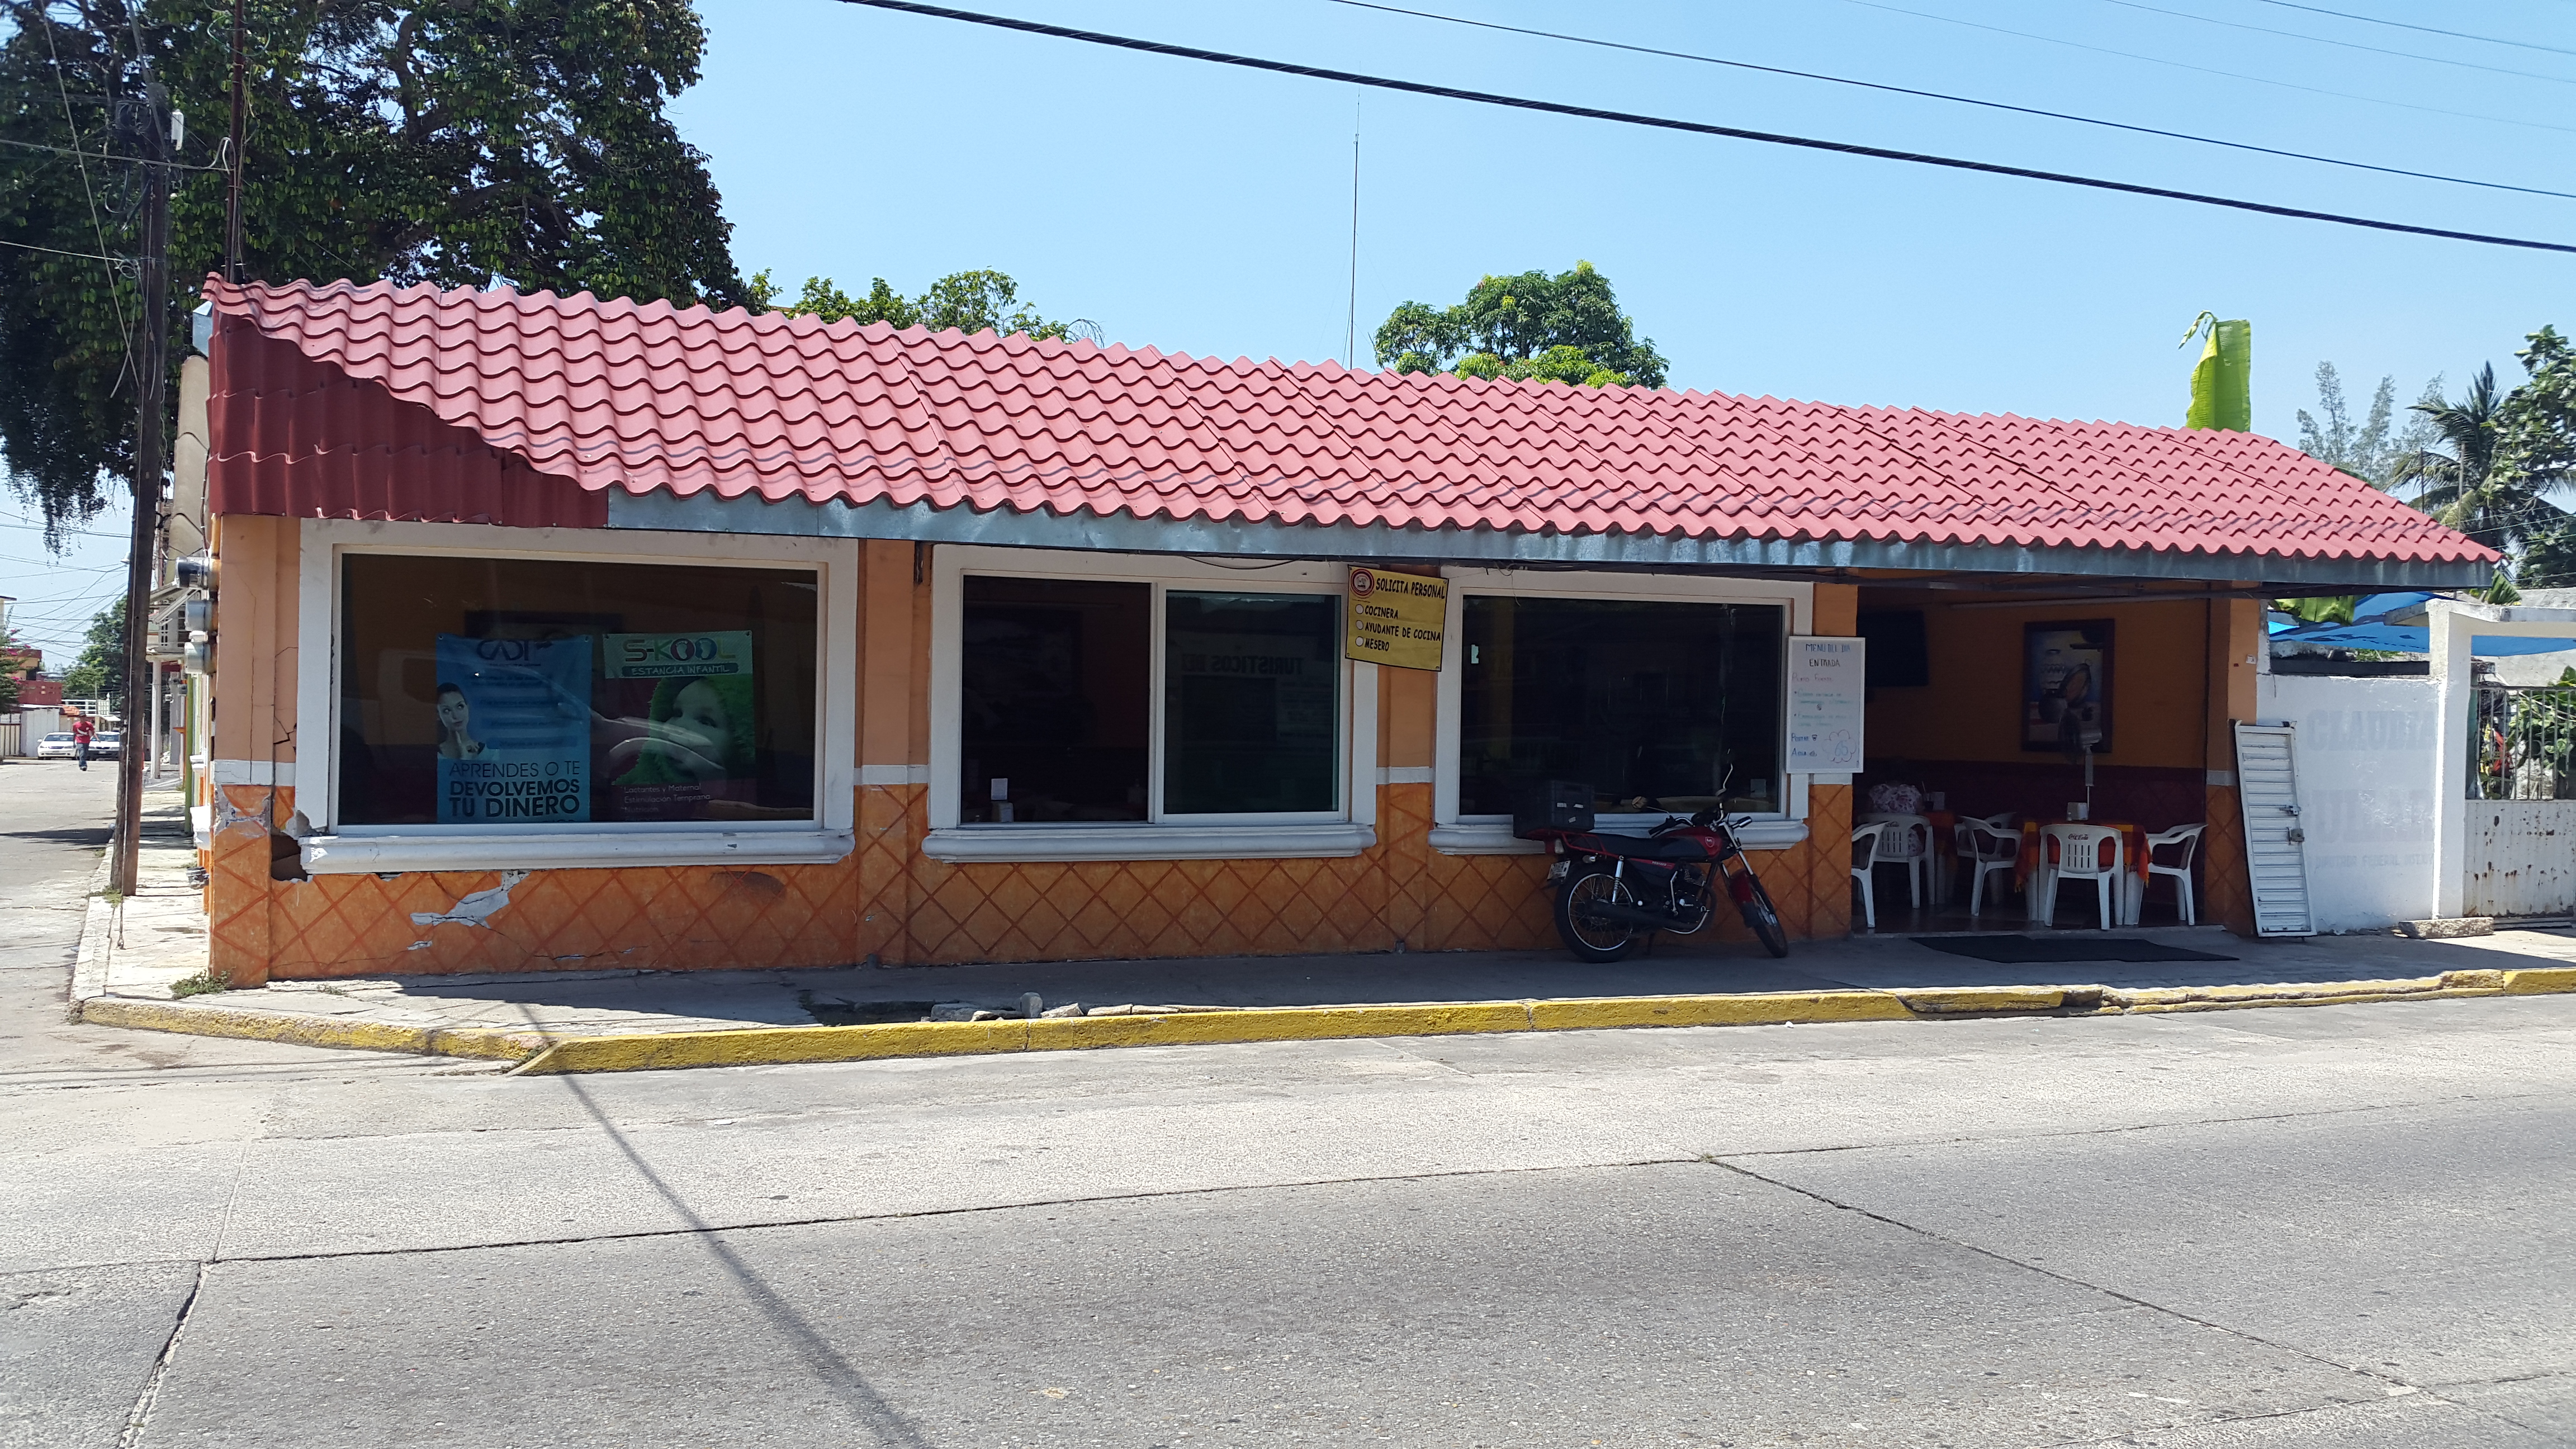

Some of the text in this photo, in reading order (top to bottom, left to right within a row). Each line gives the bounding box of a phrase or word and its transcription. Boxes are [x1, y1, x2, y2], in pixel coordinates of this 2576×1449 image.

[1376, 578, 1408, 594] SOLICITA
[1411, 581, 1445, 599] PERSONAL
[1365, 605, 1398, 619] COCINERA
[1365, 622, 1441, 641] AYUDANTE DE COCINA
[1365, 638, 1389, 651] MESERO
[1809, 659, 1841, 667] ENTRADA
[632, 667, 683, 675] ESTANCIA
[449, 760, 580, 778] APRENDES O TE
[449, 779, 580, 797] DEVOLVEMOS
[669, 783, 701, 792] Maternal
[674, 794, 711, 803] Temprana
[449, 795, 580, 817] TU DINERO
